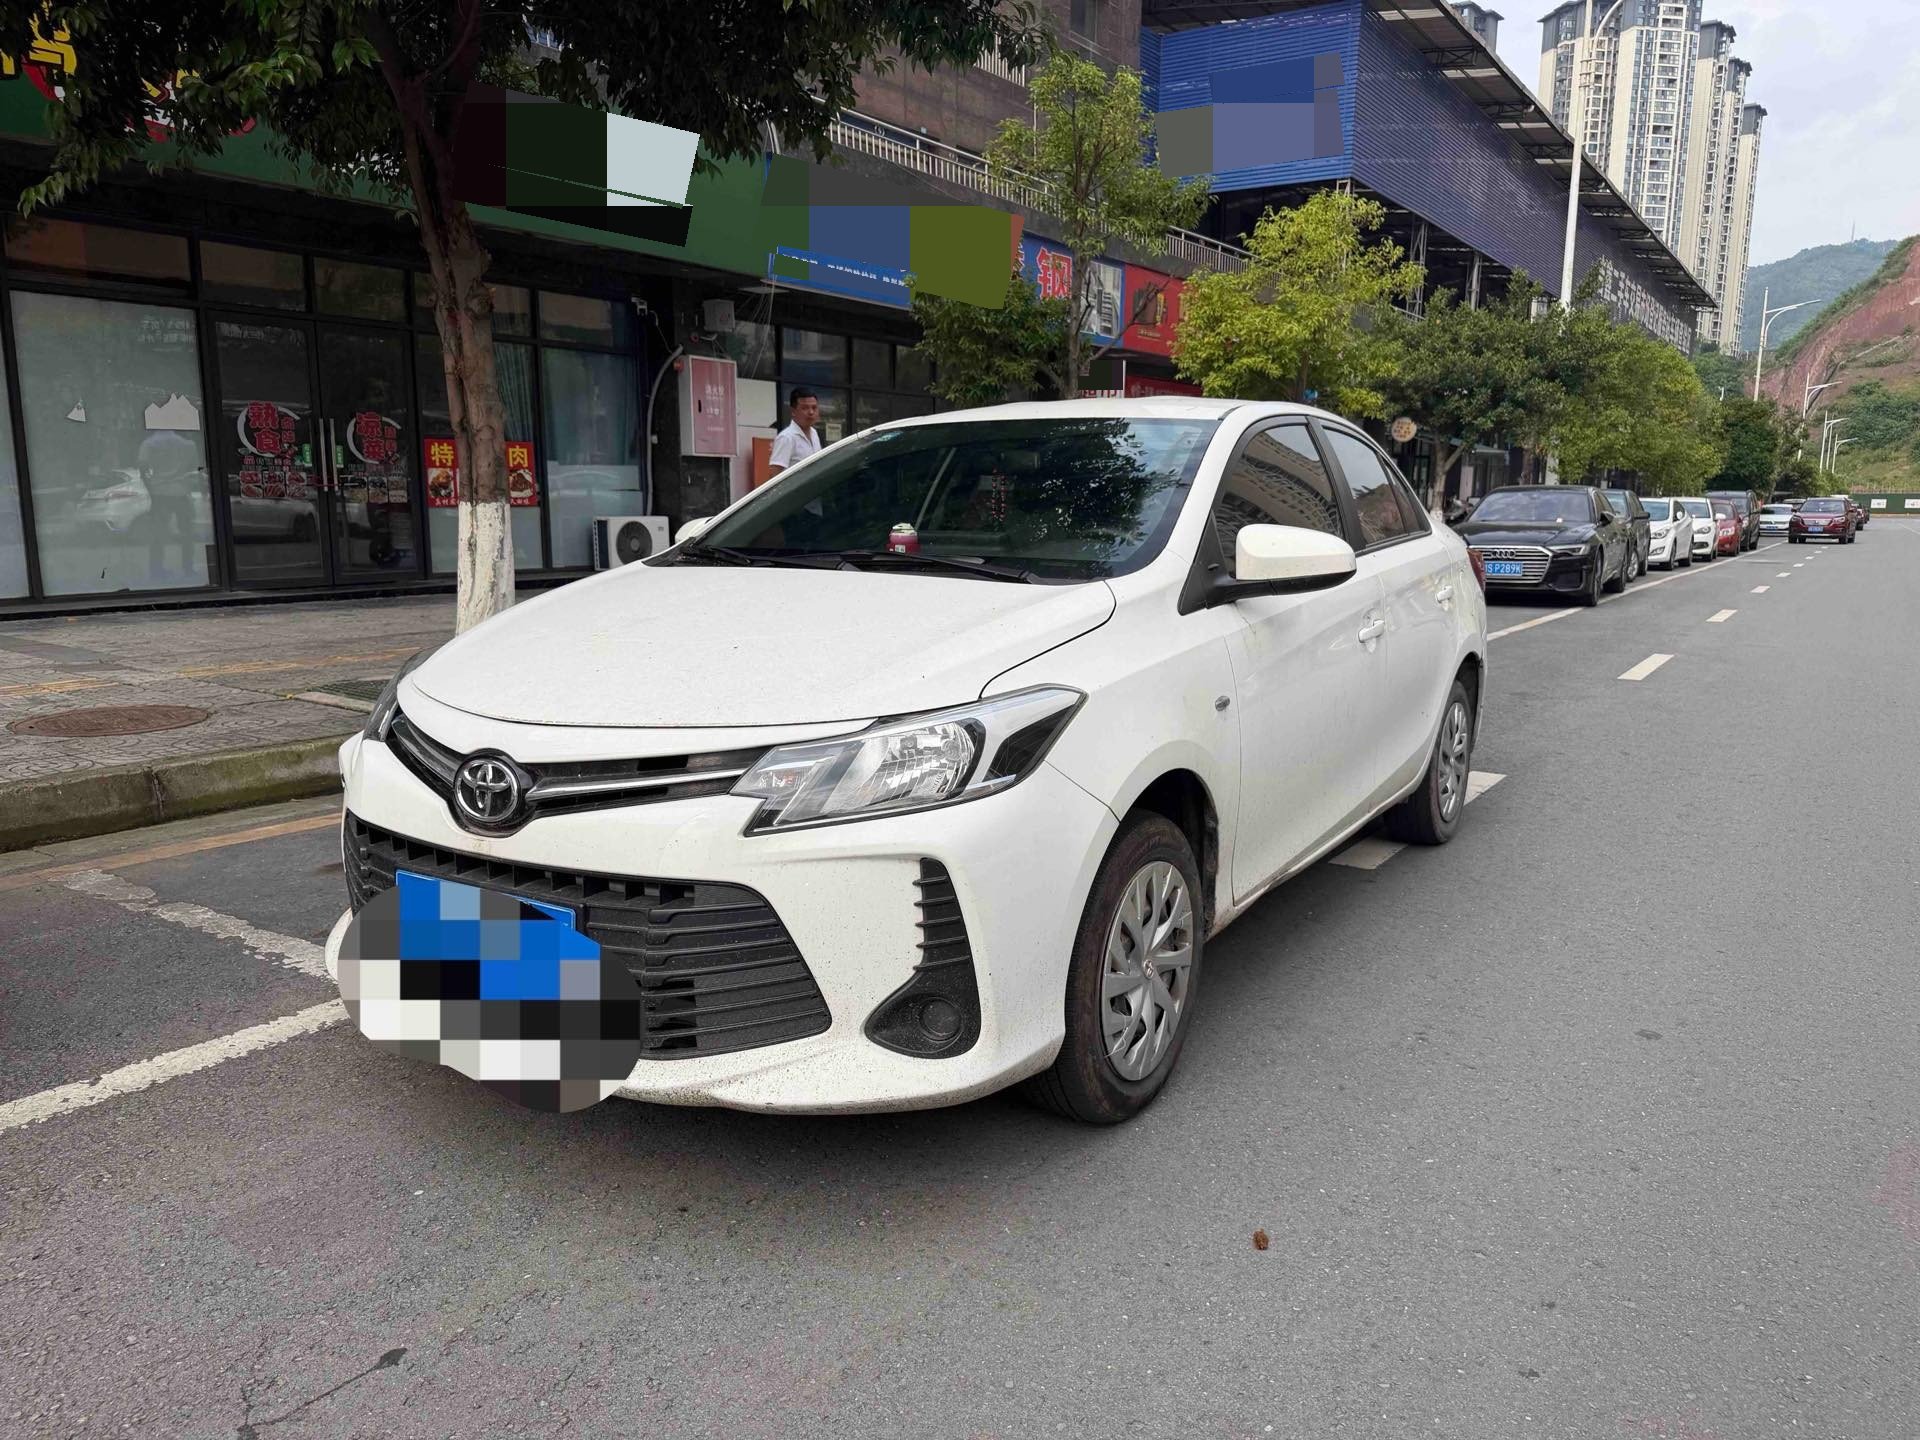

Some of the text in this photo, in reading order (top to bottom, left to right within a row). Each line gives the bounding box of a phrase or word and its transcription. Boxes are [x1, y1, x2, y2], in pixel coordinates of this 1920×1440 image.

[1018, 242, 1073, 300] 钢
[431, 442, 529, 467] 特 肉
[1486, 563, 1521, 574] SP289K
